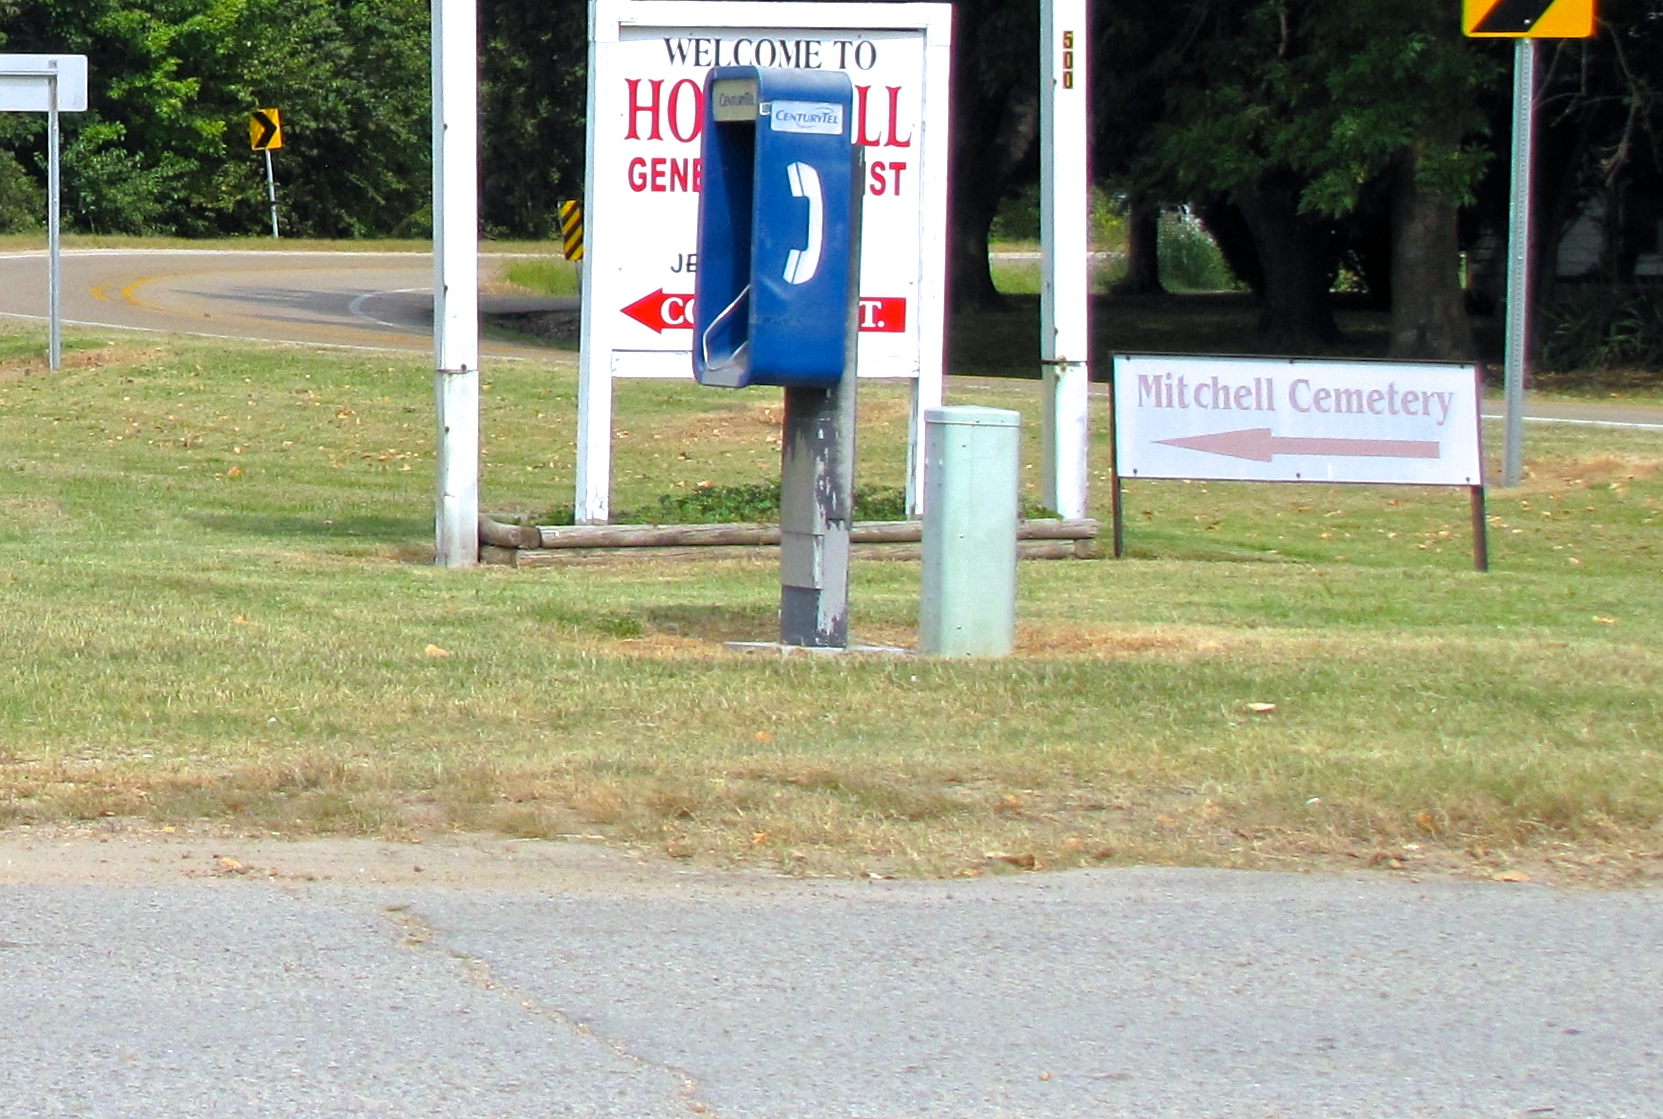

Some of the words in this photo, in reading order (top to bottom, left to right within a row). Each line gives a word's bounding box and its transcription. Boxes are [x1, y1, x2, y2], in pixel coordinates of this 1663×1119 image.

[663, 37, 822, 70] WELCOME
[833, 40, 877, 71] TO
[1137, 371, 1276, 412] Mitchell
[1288, 377, 1454, 426] Cemetery
